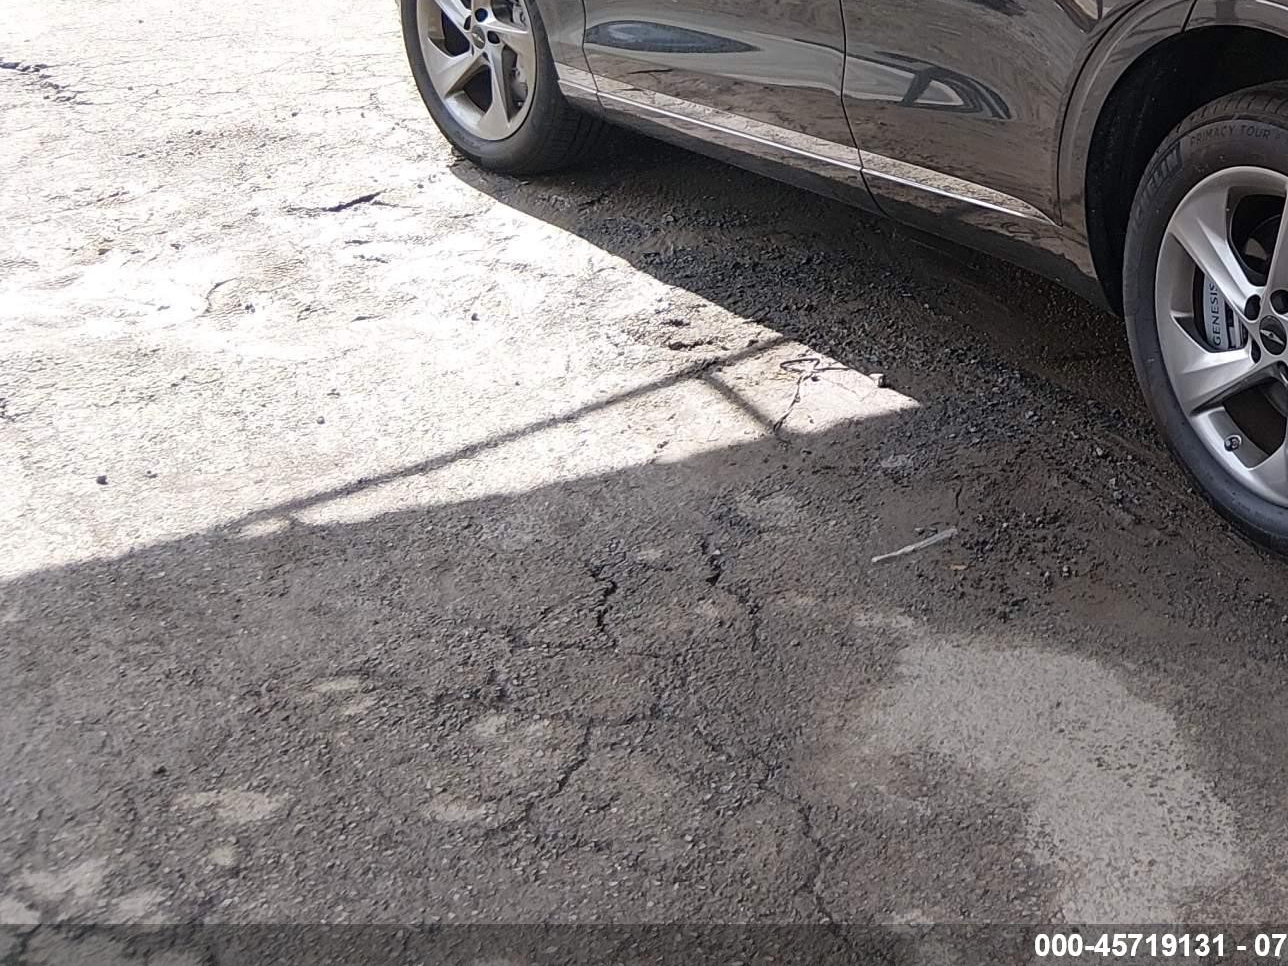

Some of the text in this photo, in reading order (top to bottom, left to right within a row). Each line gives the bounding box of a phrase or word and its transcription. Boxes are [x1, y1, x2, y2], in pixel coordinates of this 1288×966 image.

[1190, 125, 1236, 146] PRIMACY
[1241, 124, 1271, 139] TOUR
[1208, 282, 1222, 346] GENESIS
